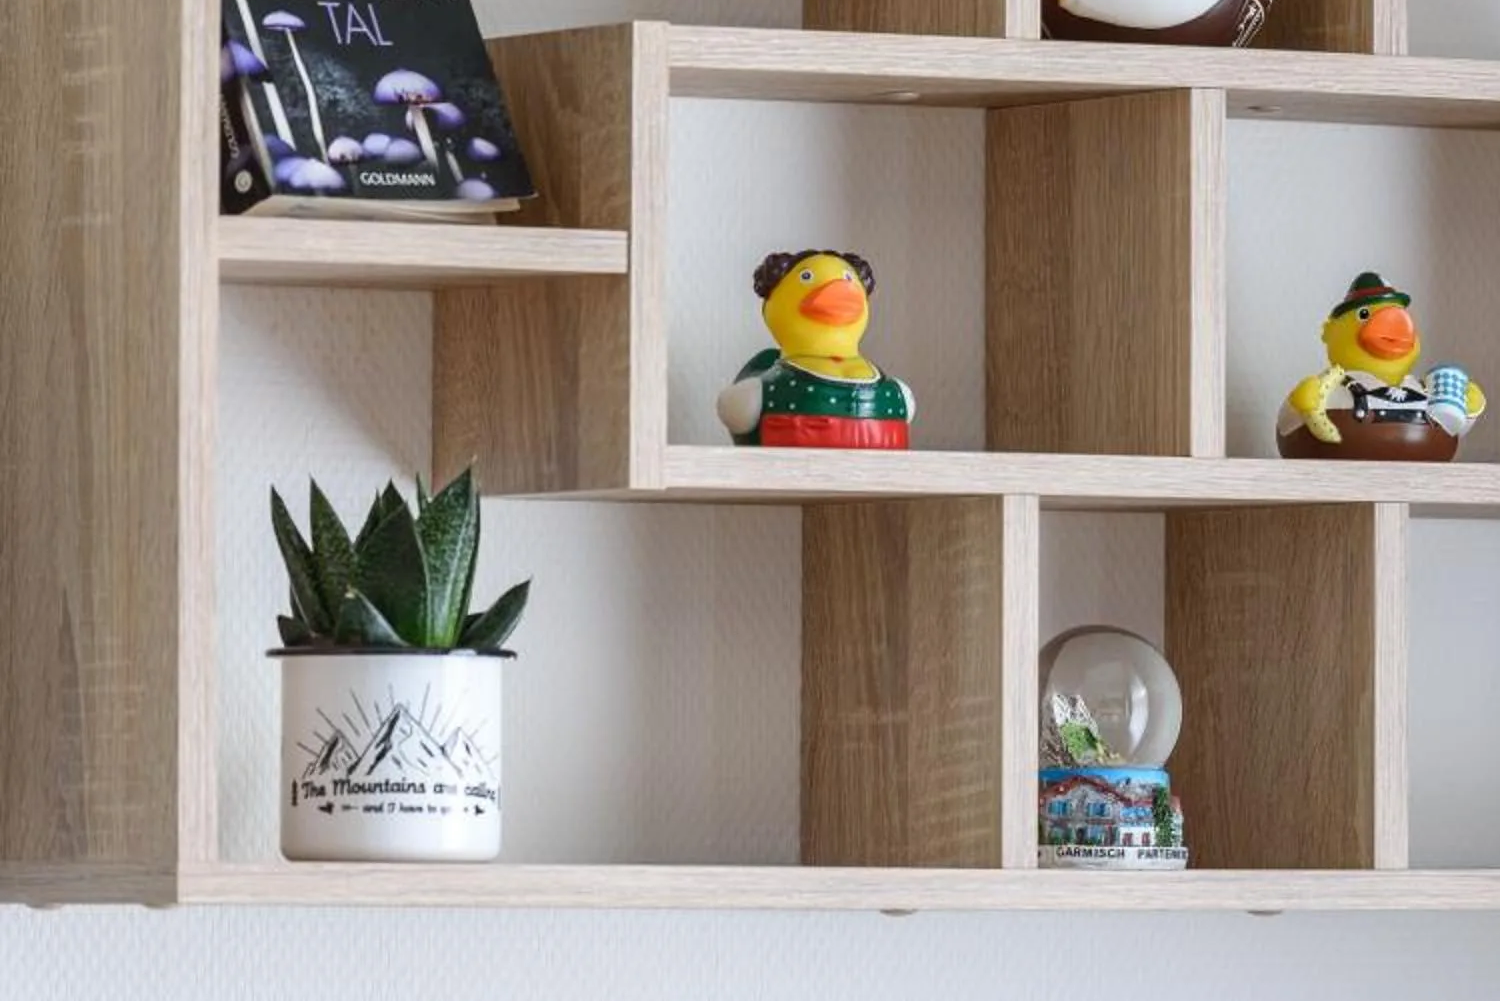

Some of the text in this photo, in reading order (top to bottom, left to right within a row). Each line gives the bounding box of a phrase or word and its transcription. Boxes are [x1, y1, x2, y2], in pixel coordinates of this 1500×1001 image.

[316, 0, 394, 47] TAL
[360, 172, 437, 187] GOLDMANN
[301, 781, 327, 799] The
[332, 777, 426, 796] Mountains
[1055, 846, 1125, 859] GARMISCH
